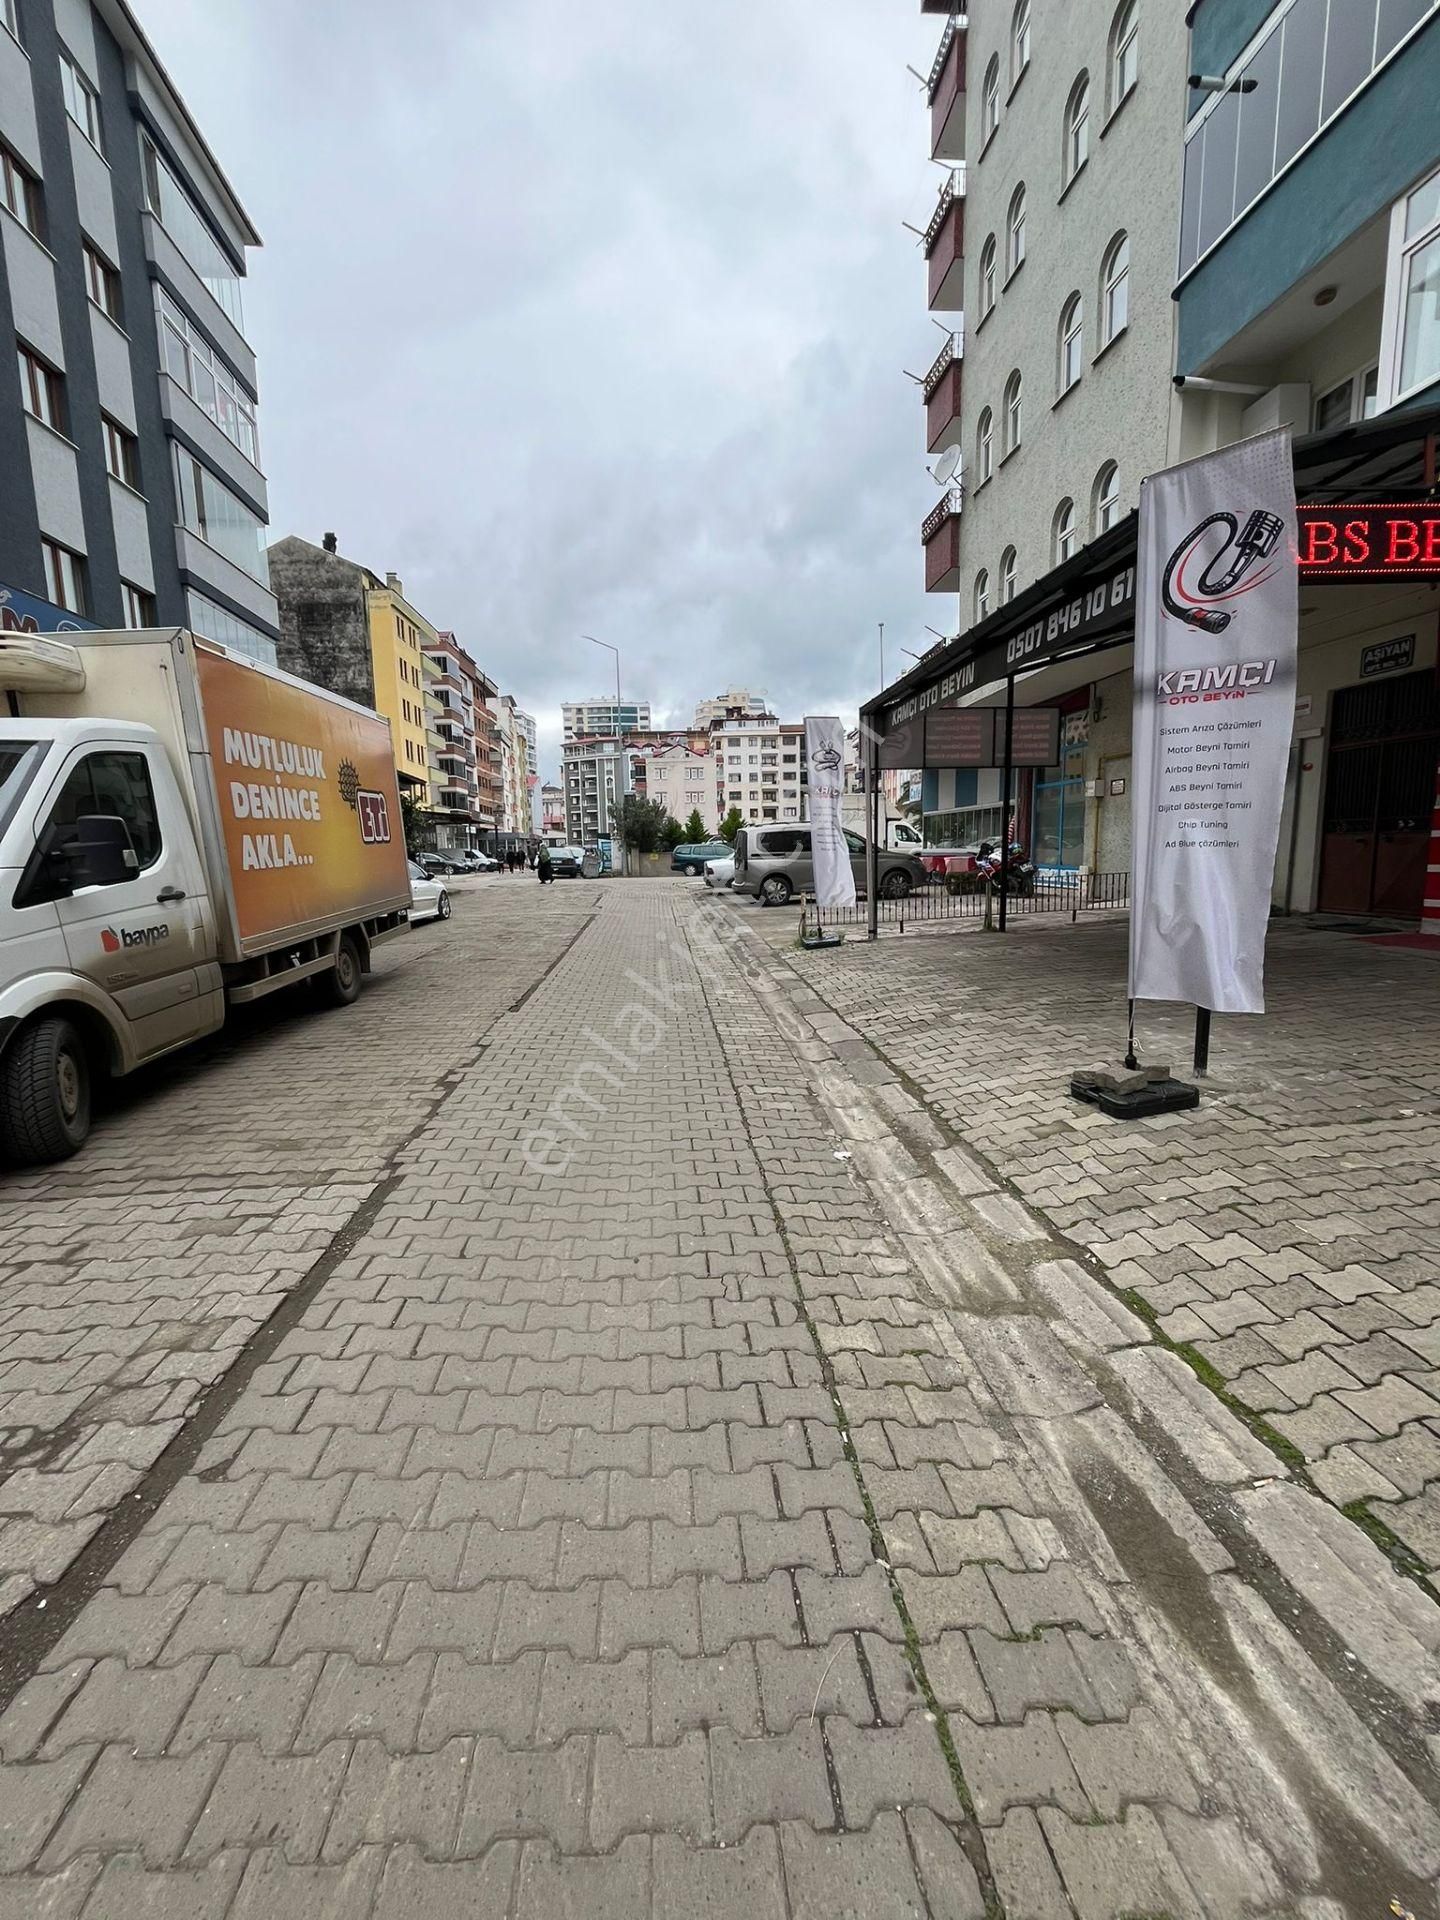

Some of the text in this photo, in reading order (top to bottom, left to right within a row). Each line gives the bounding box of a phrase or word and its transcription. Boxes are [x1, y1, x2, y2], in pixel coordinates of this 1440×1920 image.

[1295, 521, 1370, 564] BS
[1007, 567, 1134, 663] 0507 846 10 61
[1157, 659, 1277, 696] KAMÇI
[891, 697, 917, 726] KAMÇI
[920, 685, 938, 711] OTO
[1169, 695, 1199, 705] OTO
[1160, 726, 1189, 736] Sistem
[1217, 720, 1262, 732] Çözümleri
[223, 727, 327, 779] MUTLULUK
[1167, 741, 1250, 754] Motor Beyni Tamiri
[1165, 761, 1250, 774] Airbag Beyni Tamiri
[1169, 781, 1243, 793] ABS Beyni Tamiri
[230, 775, 321, 821] DENİNCE
[1184, 801, 1224, 811] Gösterge
[1225, 801, 1252, 810] Tamiri
[1178, 820, 1228, 830] Chip Tuning
[242, 834, 314, 870] AKLA...
[1165, 840, 1177, 849] Ad
[1179, 840, 1196, 848] Blue
[121, 924, 169, 948] baypa
